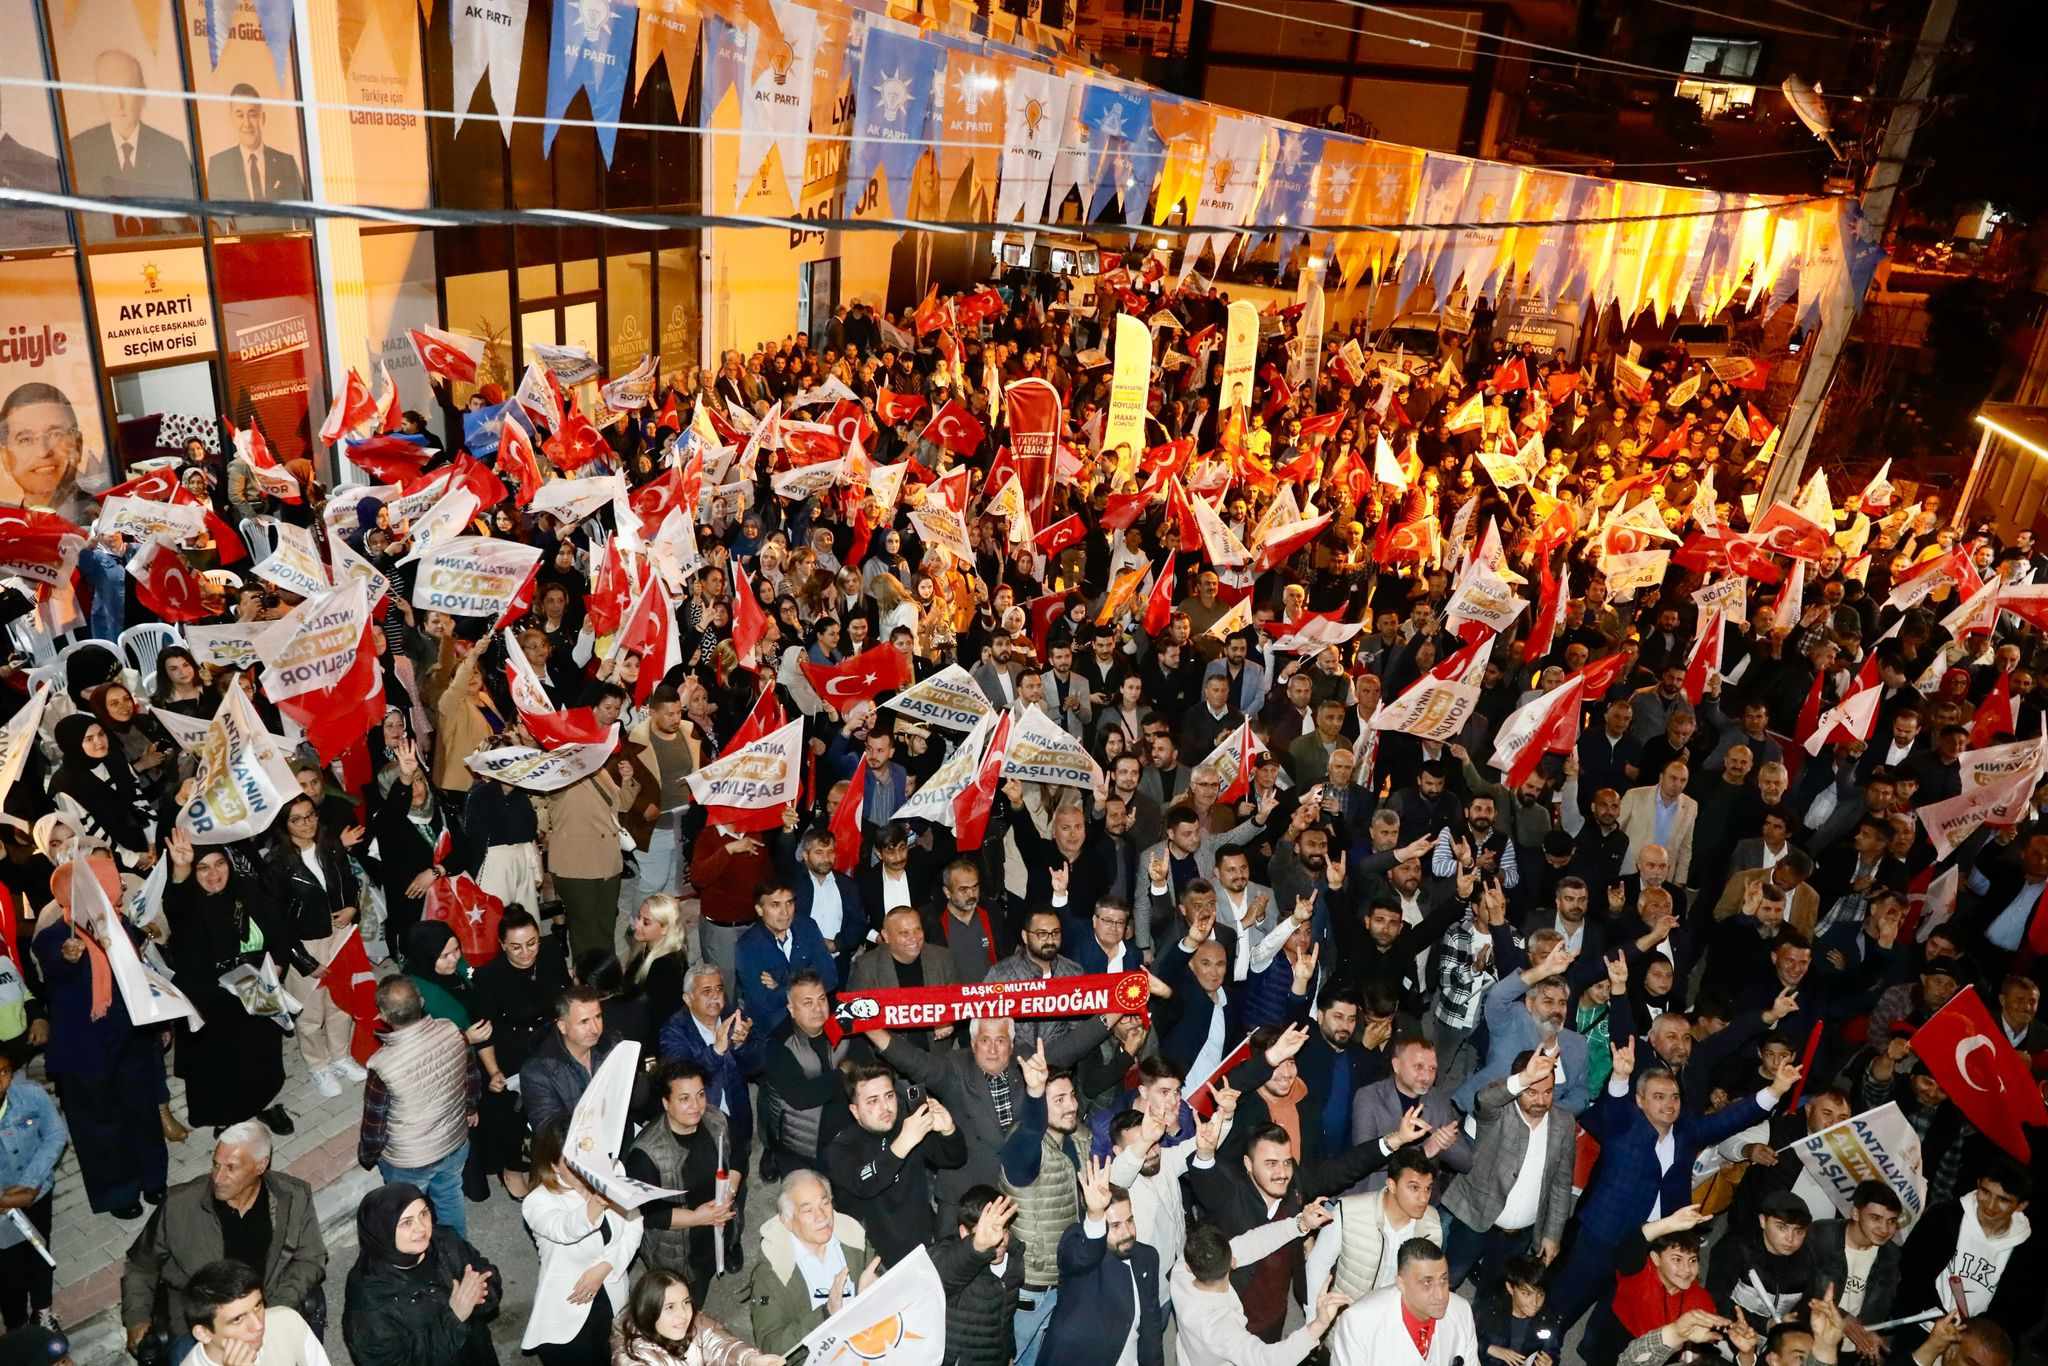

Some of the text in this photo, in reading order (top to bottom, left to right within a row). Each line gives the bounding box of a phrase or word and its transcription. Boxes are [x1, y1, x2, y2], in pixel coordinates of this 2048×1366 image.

[465, 6, 483, 19] AK
[564, 45, 580, 57] AK
[755, 91, 770, 103] AK
[120, 293, 193, 321] AK PARTİ
[107, 327, 142, 339] ALANYA
[124, 332, 197, 358] SEÇİM OFİSİ
[240, 330, 308, 362] DAHASI VAR!
[898, 697, 981, 727] BAŞLIYOR
[221, 712, 268, 814] ANTALYA'NIN
[1005, 762, 1091, 784] BAŞLIYOR
[884, 988, 1109, 1025] RECEP TAYYİP ERDOĞAN
